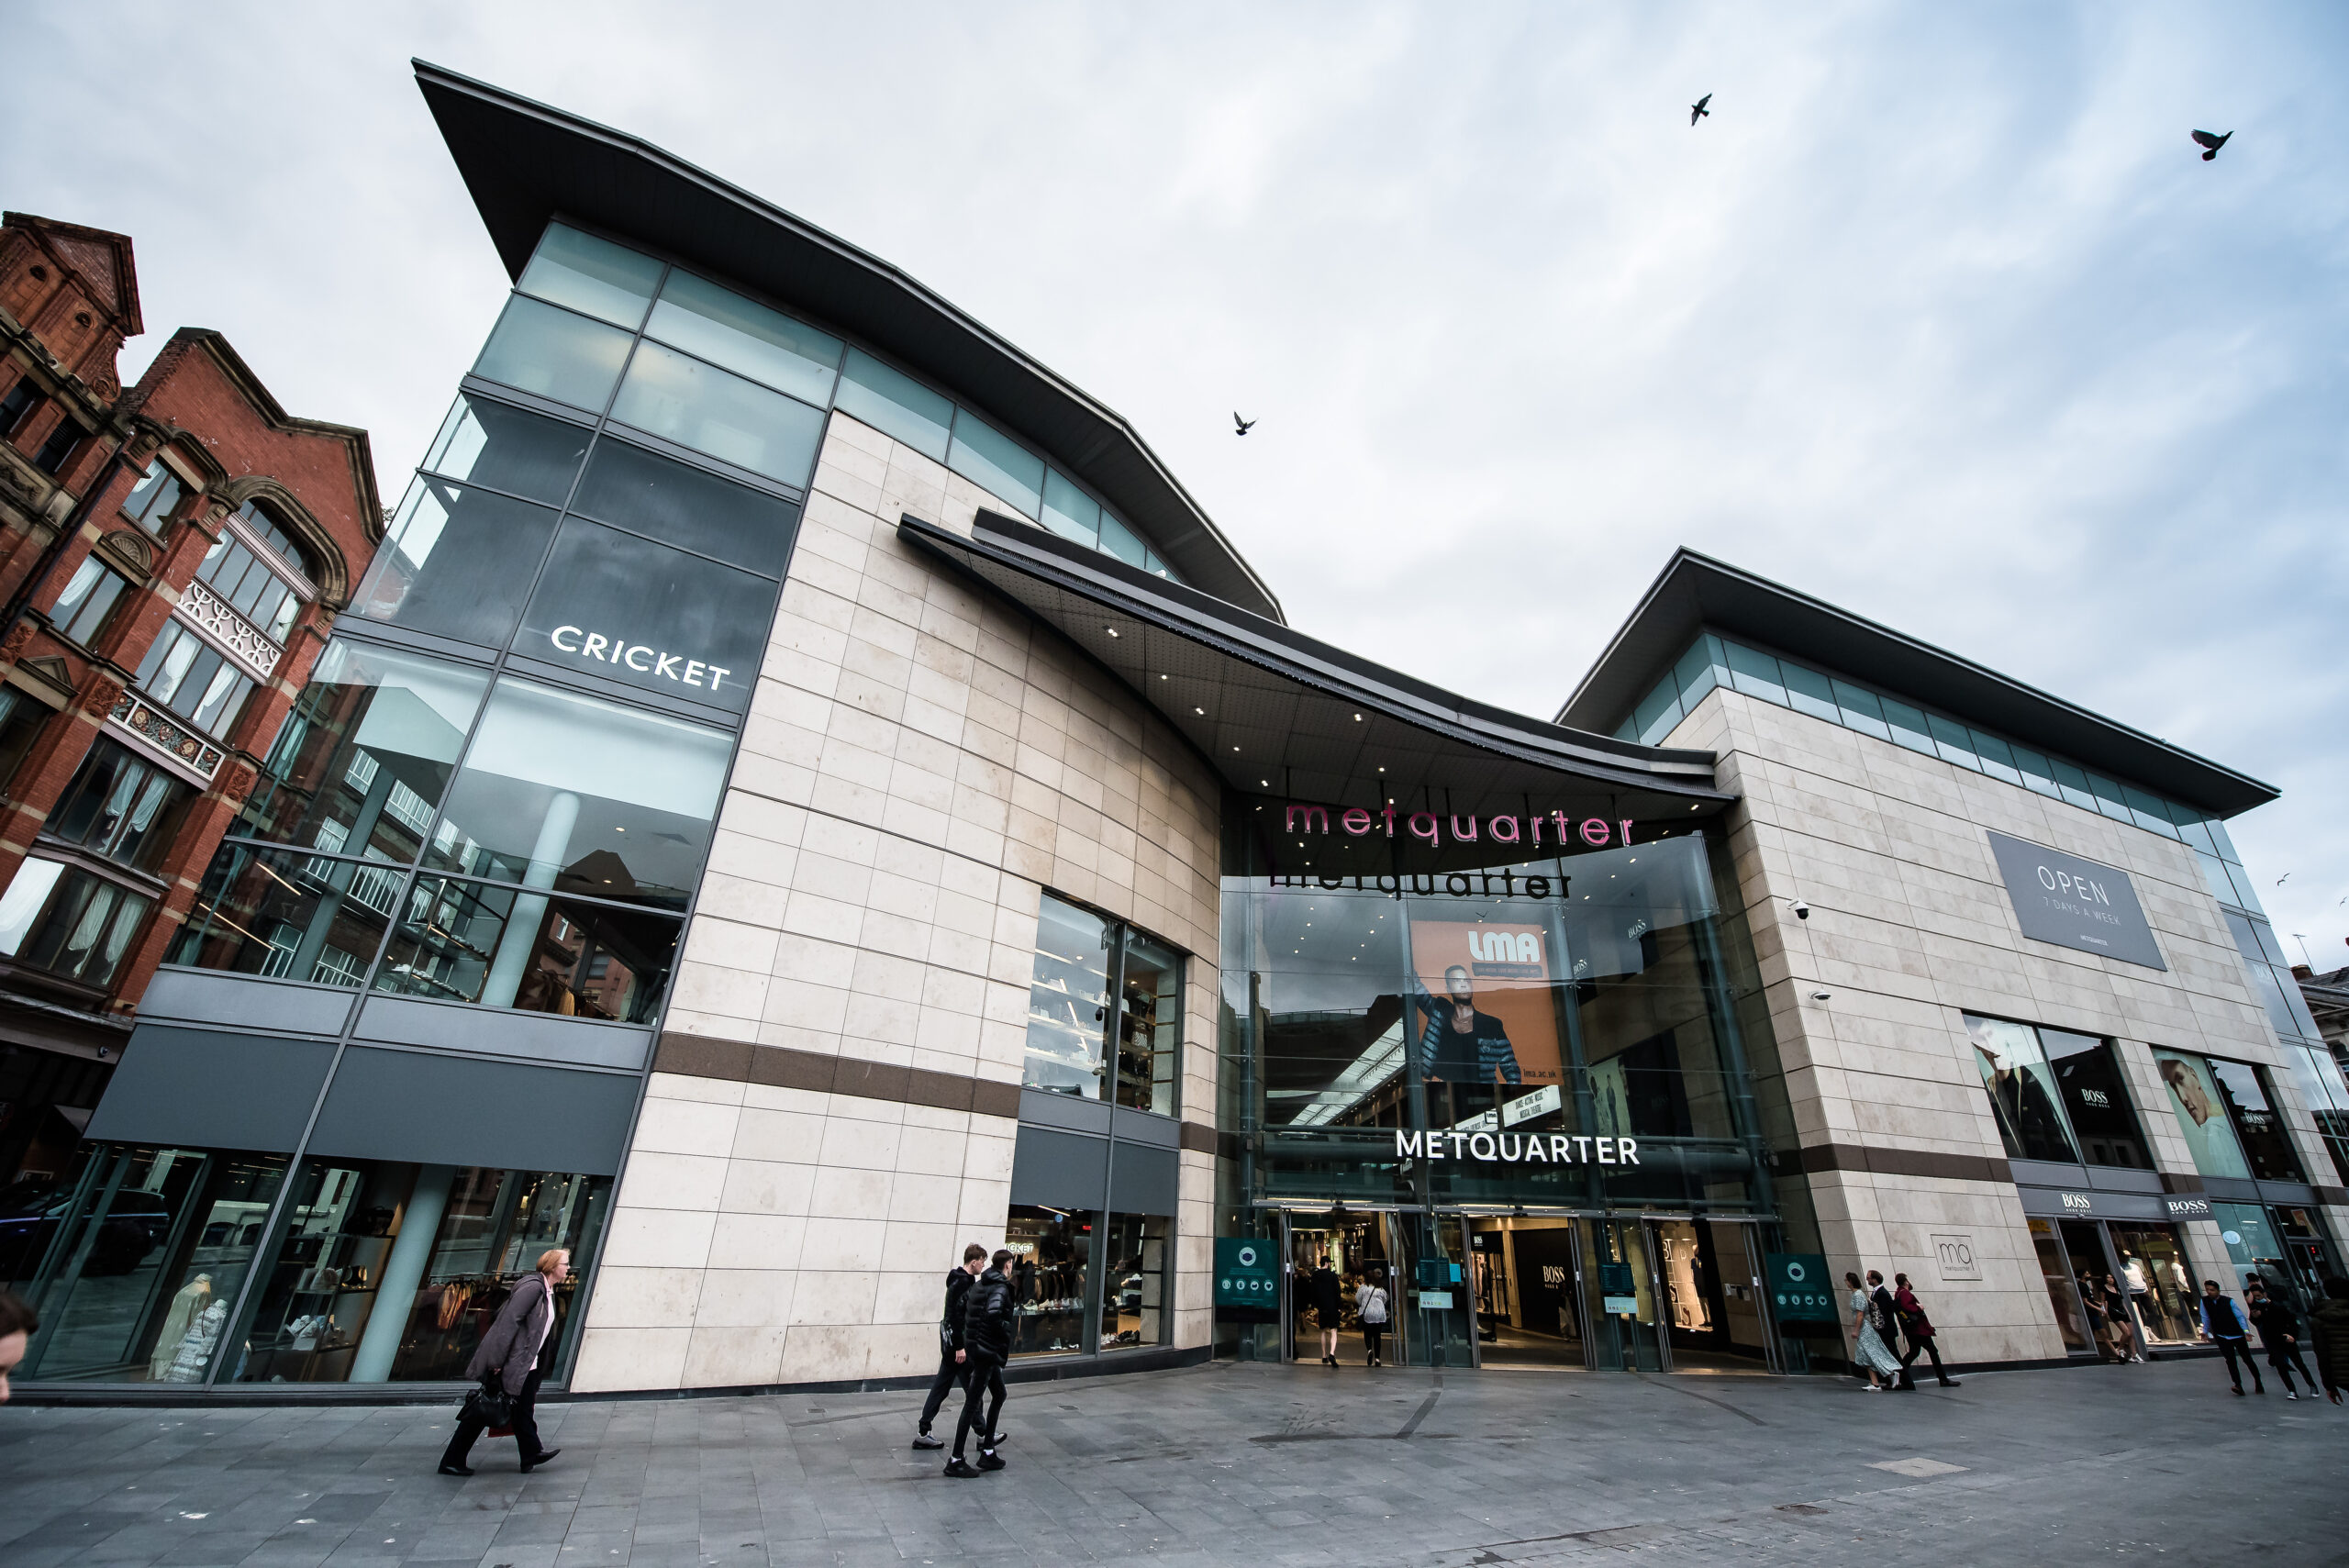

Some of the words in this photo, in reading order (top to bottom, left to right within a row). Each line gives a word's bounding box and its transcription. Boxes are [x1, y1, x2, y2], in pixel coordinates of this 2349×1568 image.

[551, 625, 730, 691] CRICKET
[1286, 802, 1633, 848] metquarter
[2038, 865, 2110, 906] OPEN
[2043, 896, 2048, 906] 7
[2053, 899, 2080, 915] DAYS
[2083, 907, 2090, 917] A
[2092, 910, 2121, 926] WEEK
[1628, 920, 1646, 939] BOSS
[1468, 930, 1541, 962] LMA
[1523, 1069, 1556, 1078] lma.ac.uk
[2081, 1088, 2109, 1104] BOSS
[2244, 1111, 2266, 1126] BOSS
[1396, 1129, 1640, 1165] METQUARTER
[2061, 1193, 2090, 1208] BOSS
[2167, 1199, 2208, 1212] BOSS
[1939, 1243, 1975, 1271] mq
[1542, 1265, 1565, 1284] BOSS
